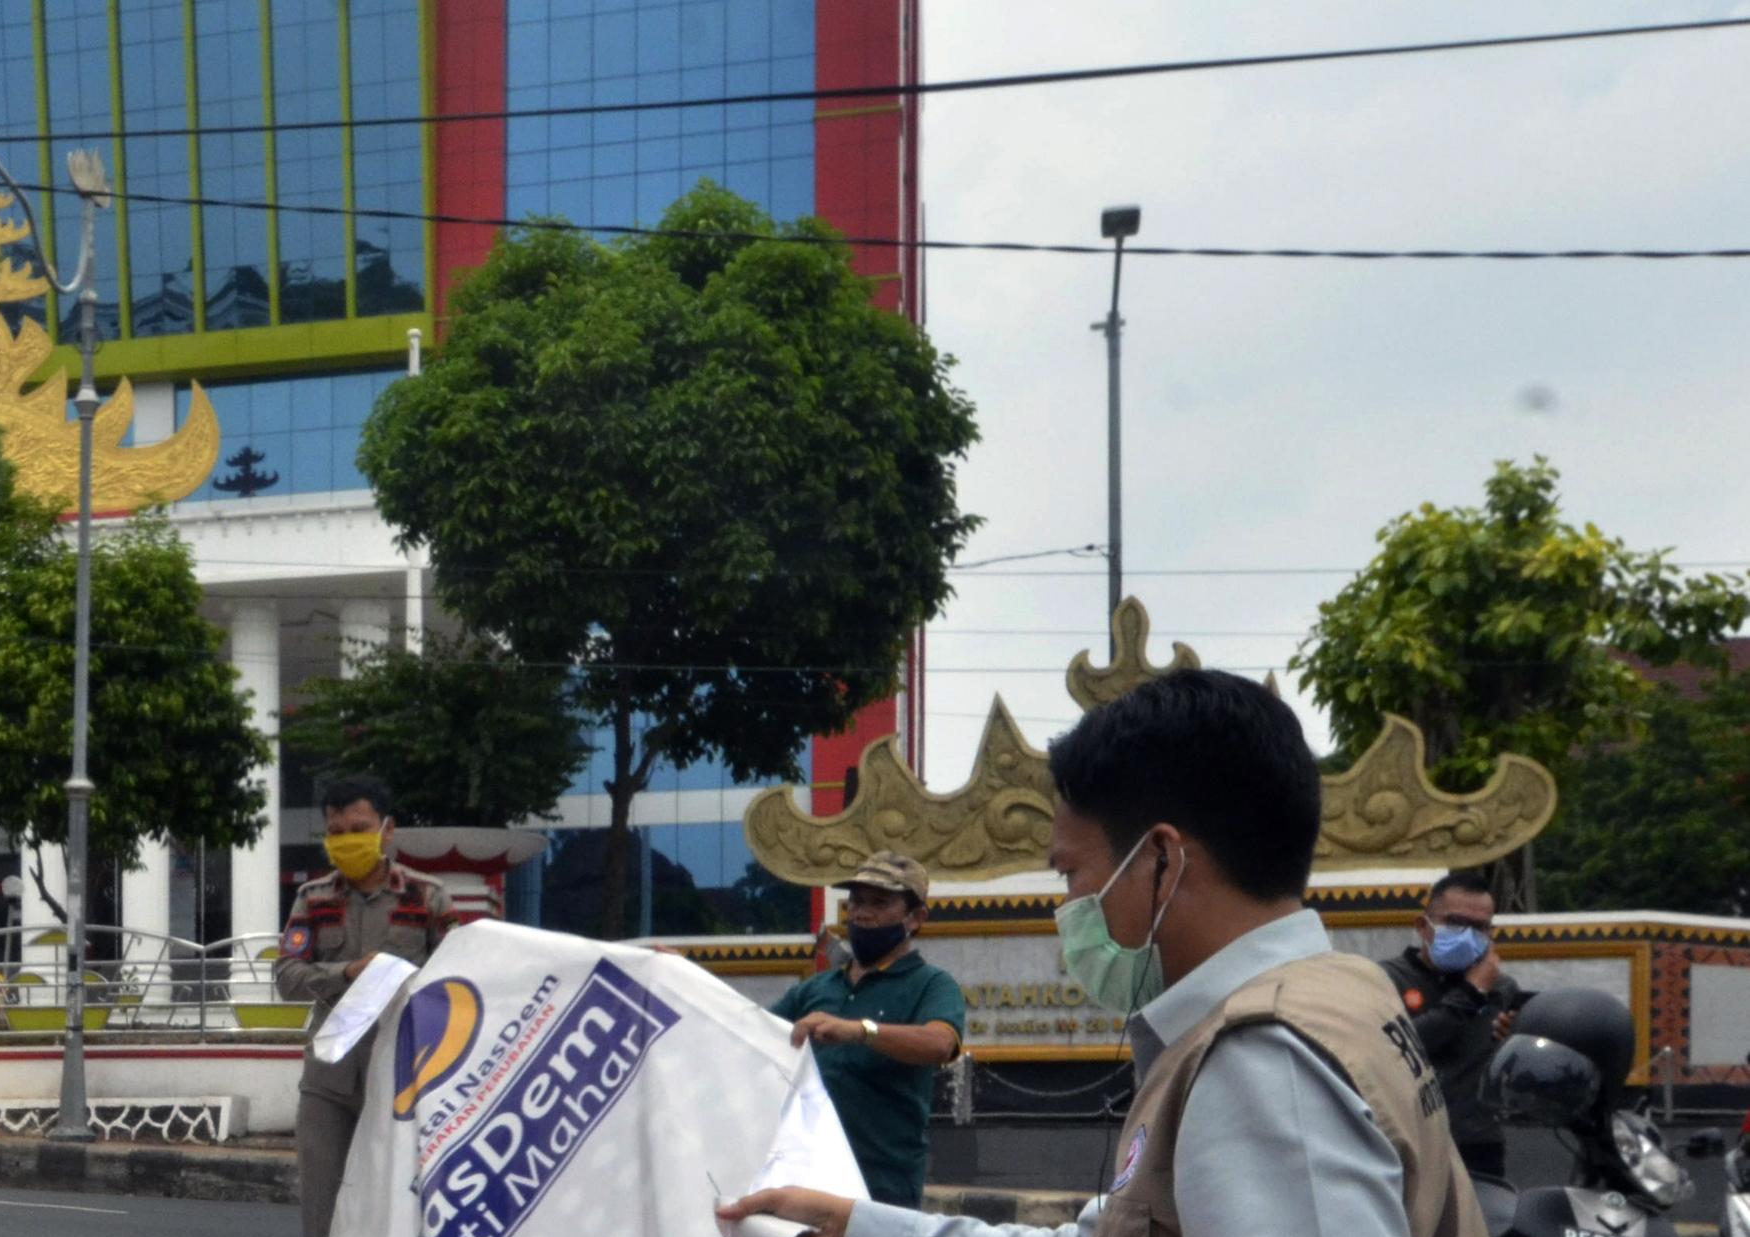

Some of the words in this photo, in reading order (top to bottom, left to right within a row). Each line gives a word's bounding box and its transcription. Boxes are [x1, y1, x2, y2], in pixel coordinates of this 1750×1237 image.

[418, 1104, 478, 1169] ERAKAN
[477, 1004, 556, 1101] PERUBAHAN
[455, 974, 558, 1098] NasDem
[504, 1025, 640, 1207] Mahar
